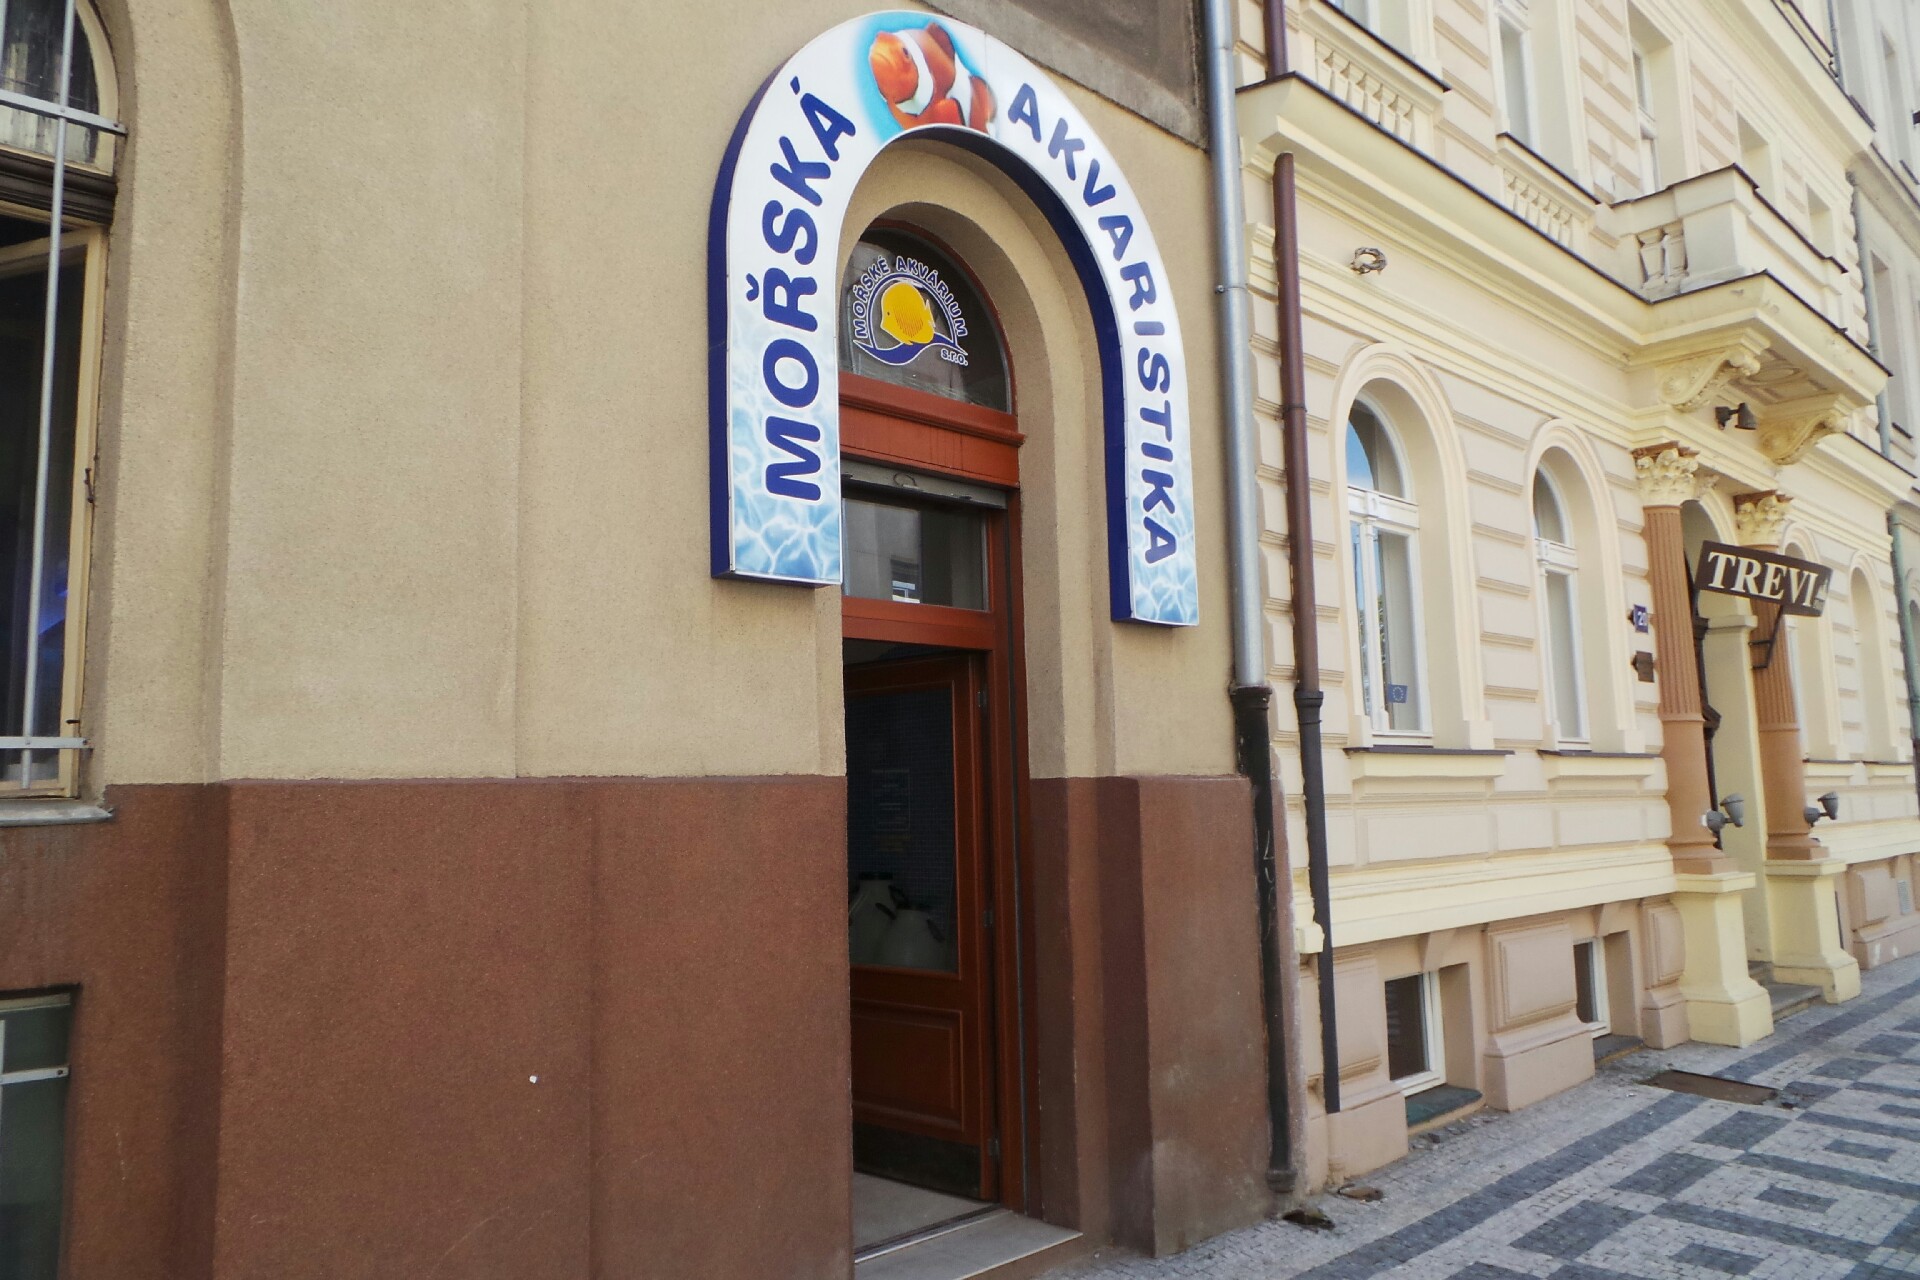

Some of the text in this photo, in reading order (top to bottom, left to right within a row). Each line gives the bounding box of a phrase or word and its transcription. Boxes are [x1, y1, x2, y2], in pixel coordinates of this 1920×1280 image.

[746, 76, 1177, 565] MOŘSKÁ AKVARISTIKA
[852, 255, 968, 339] MOŘSKÉ AKVÁRIUM
[940, 348, 968, 366] s.r.o.
[1707, 551, 1819, 607] TREVI
